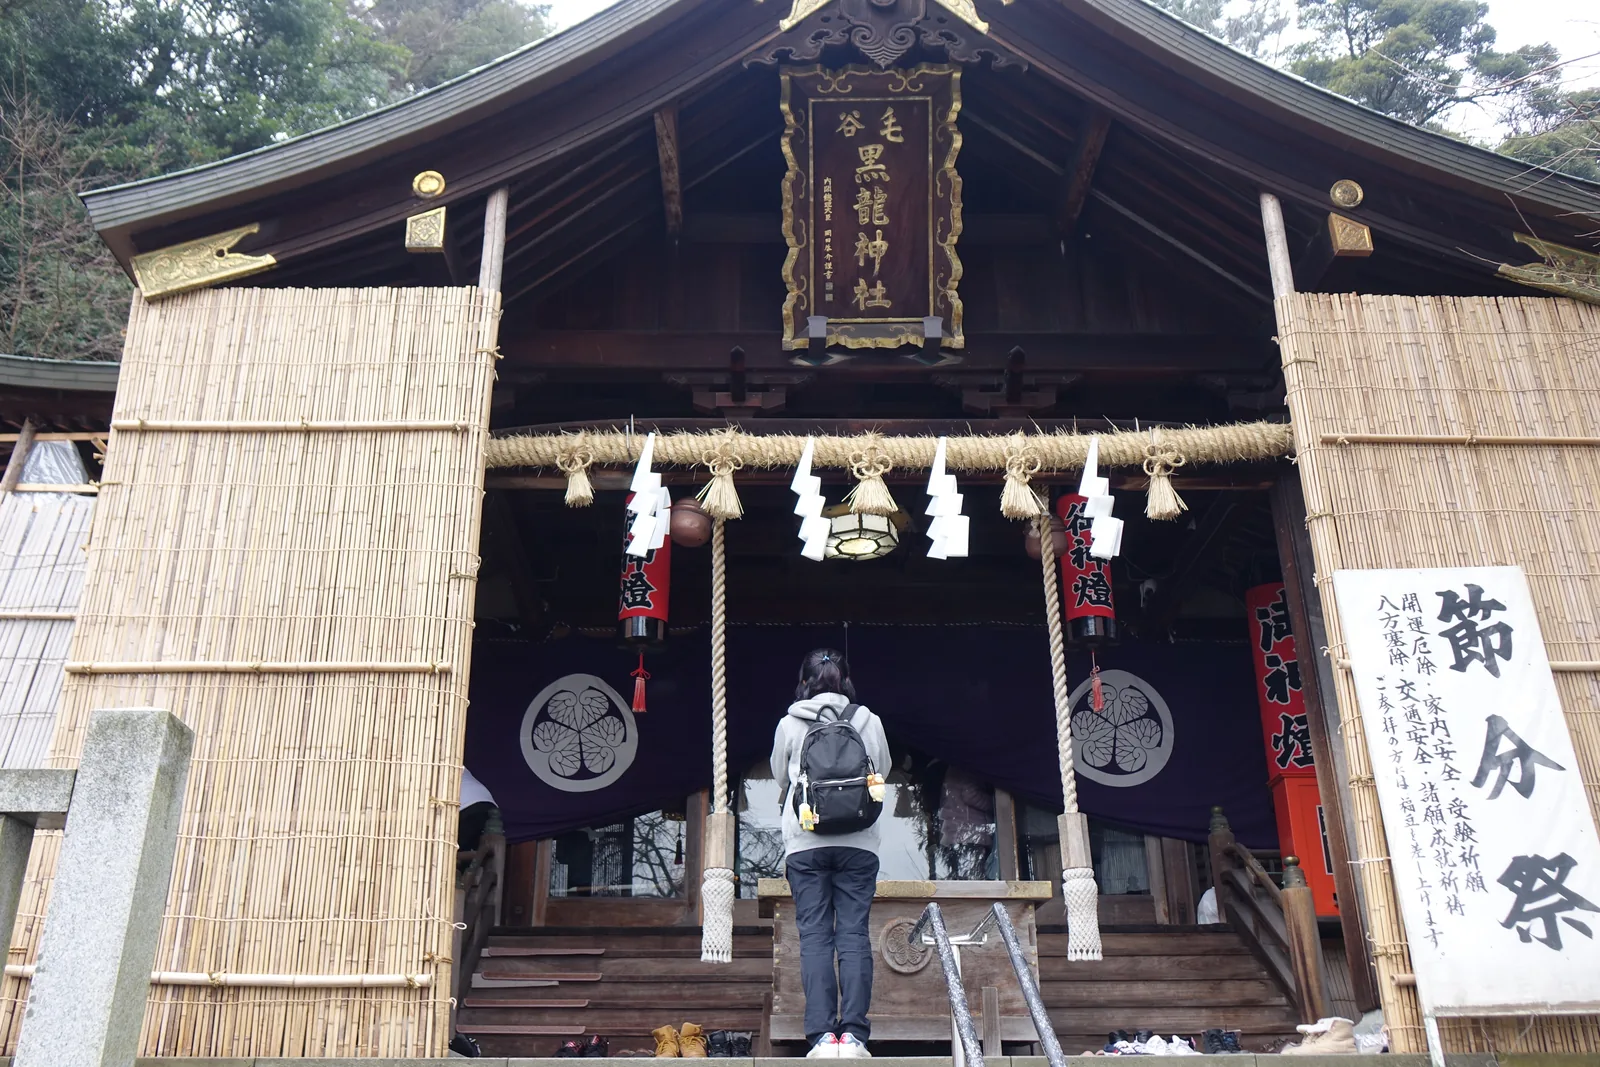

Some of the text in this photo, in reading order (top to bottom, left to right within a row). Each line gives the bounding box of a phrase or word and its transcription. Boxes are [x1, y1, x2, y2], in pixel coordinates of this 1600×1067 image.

[835, 106, 905, 143] 毛谷
[1436, 583, 1600, 952] 節分祭
